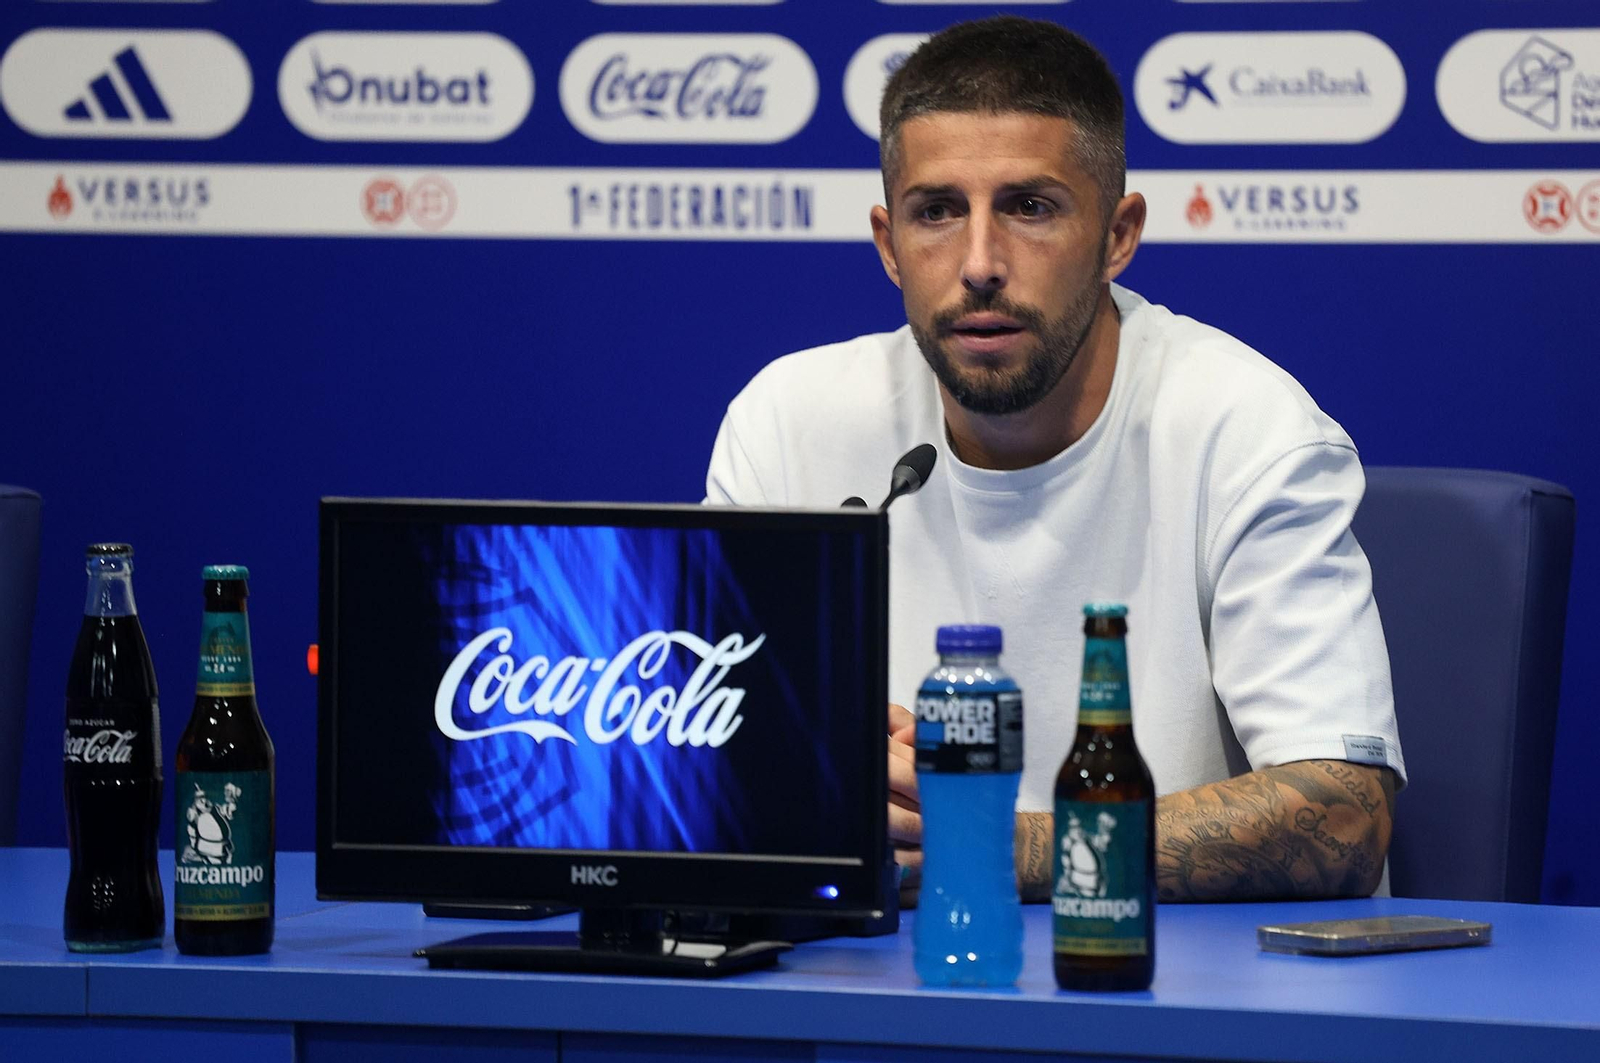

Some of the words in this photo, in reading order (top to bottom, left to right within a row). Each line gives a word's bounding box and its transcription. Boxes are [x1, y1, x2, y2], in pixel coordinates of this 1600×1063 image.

[1228, 66, 1371, 96] CaixaBank
[78, 177, 210, 206] VERSUS
[1218, 184, 1360, 214] VERSUS
[434, 627, 766, 748] Coca-Cola
[916, 698, 996, 722] POWER
[944, 721, 996, 745] ADE
[175, 865, 264, 888] ruzcampo
[571, 864, 618, 887] HKC
